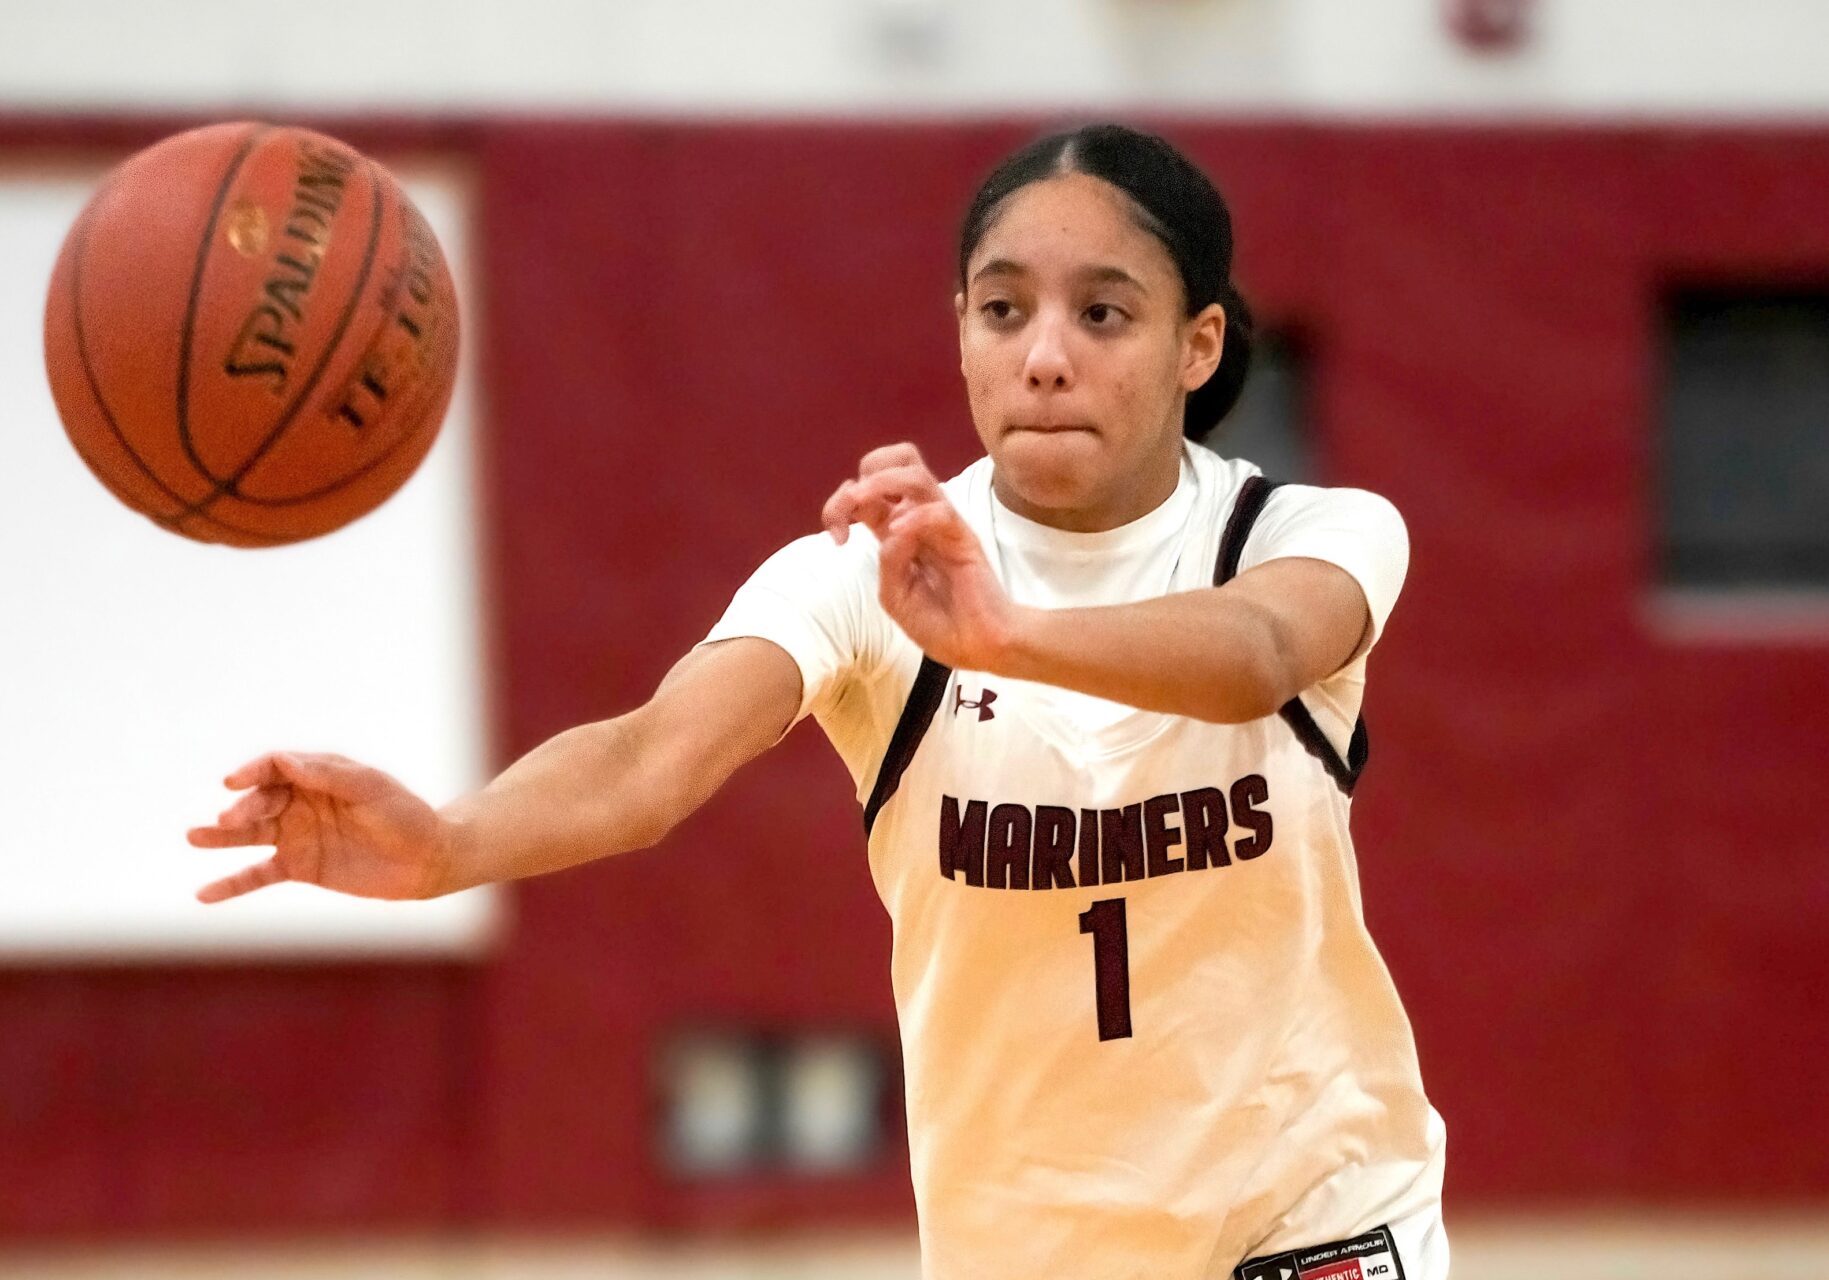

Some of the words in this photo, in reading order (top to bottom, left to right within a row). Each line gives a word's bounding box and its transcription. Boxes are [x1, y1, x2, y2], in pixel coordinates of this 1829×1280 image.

[939, 774, 1273, 890] MARINERS
[1078, 897, 1133, 1042] 1
[1300, 1249, 1339, 1265] UNDER
[1340, 1239, 1385, 1255] ARMOUR
